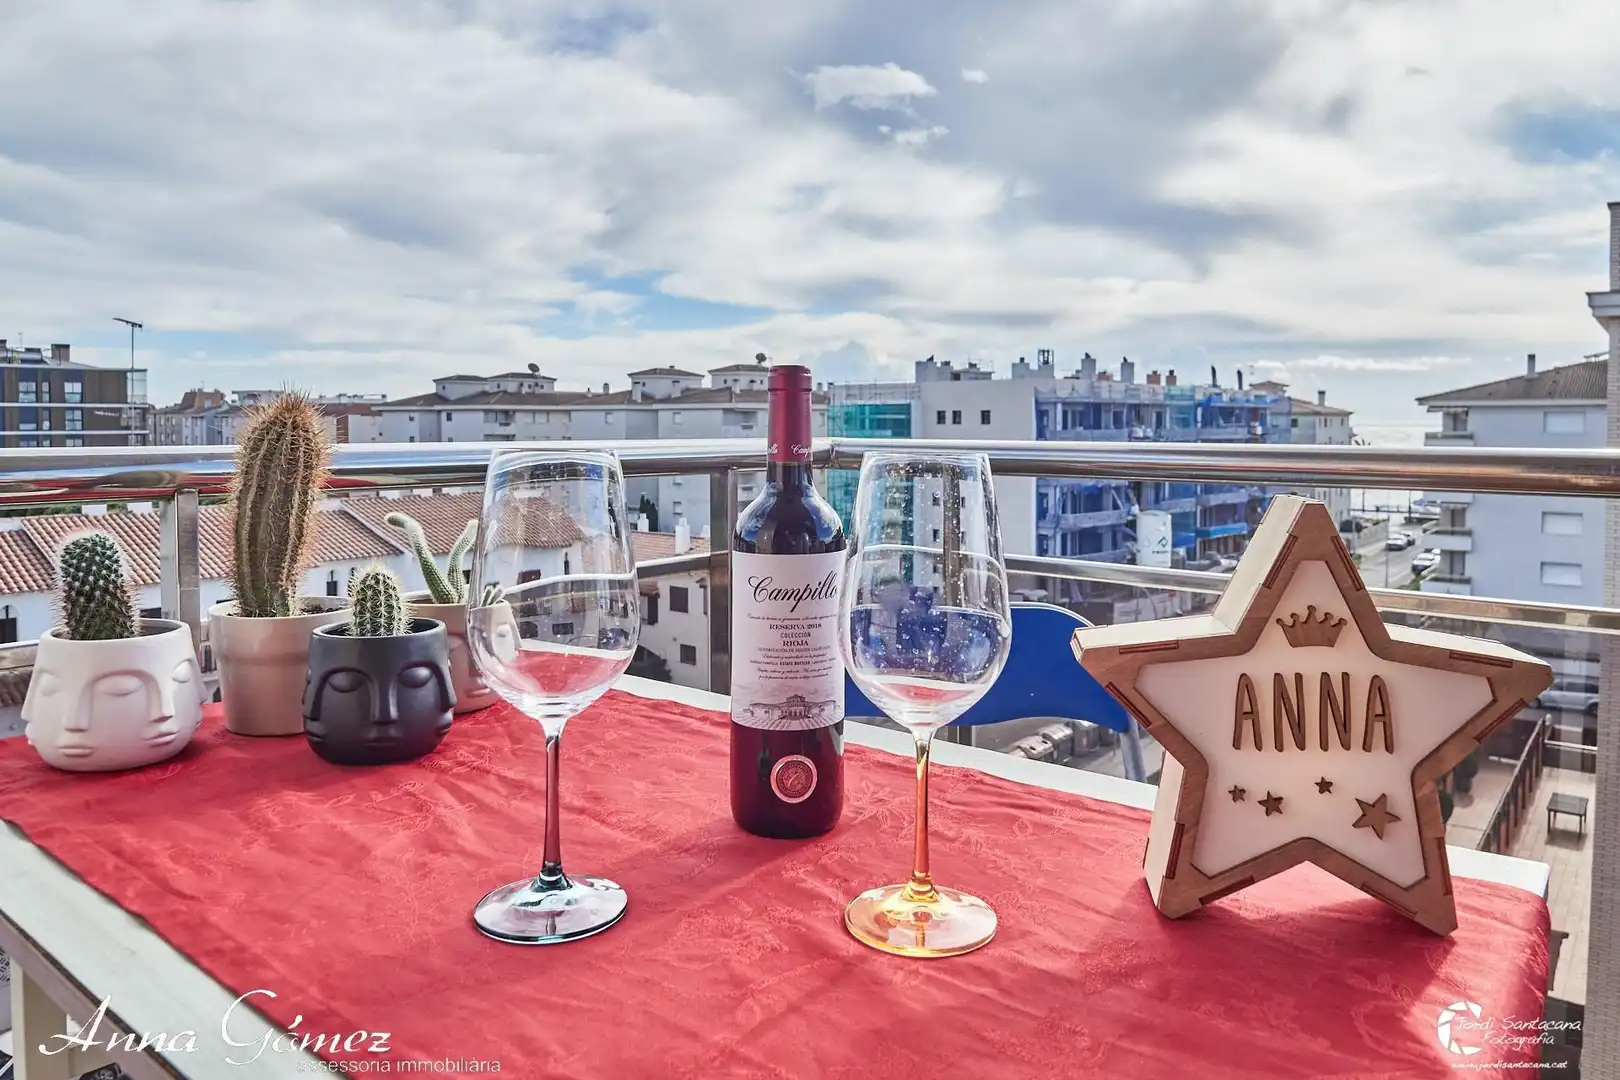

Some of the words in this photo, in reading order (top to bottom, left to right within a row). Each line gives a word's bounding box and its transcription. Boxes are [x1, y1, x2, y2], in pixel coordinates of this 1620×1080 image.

[747, 571, 837, 613] Campillo
[780, 631, 811, 639] COLECCIÓN
[1232, 671, 1394, 754] ANNA
